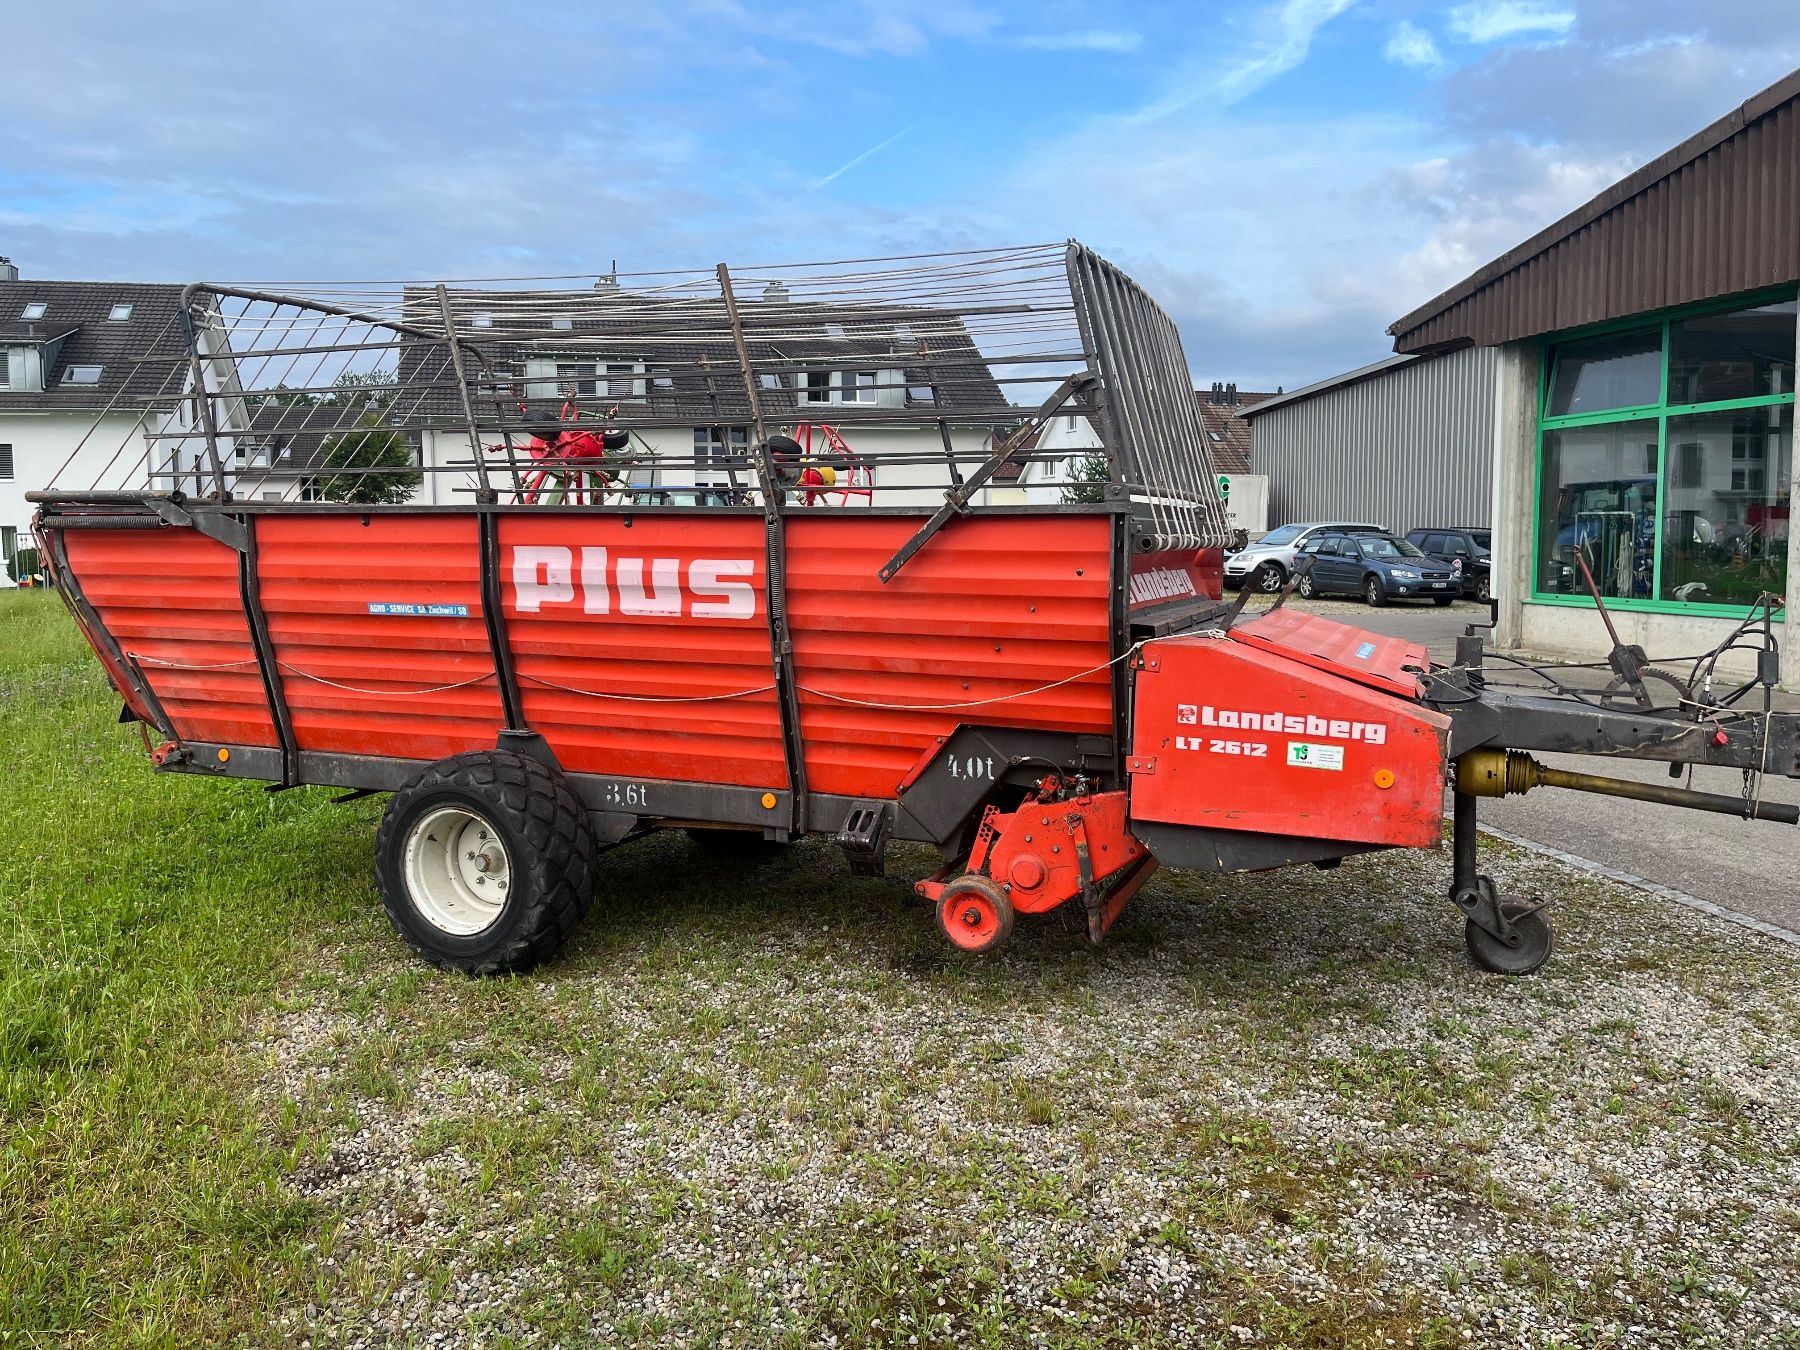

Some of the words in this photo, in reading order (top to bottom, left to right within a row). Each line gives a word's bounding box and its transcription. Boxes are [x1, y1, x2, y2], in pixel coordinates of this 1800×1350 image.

[390, 604, 414, 614] SERVICE
[1201, 705, 1387, 745] Landsberg
[1175, 736, 1203, 751] LT
[1209, 739, 1268, 758] 2612
